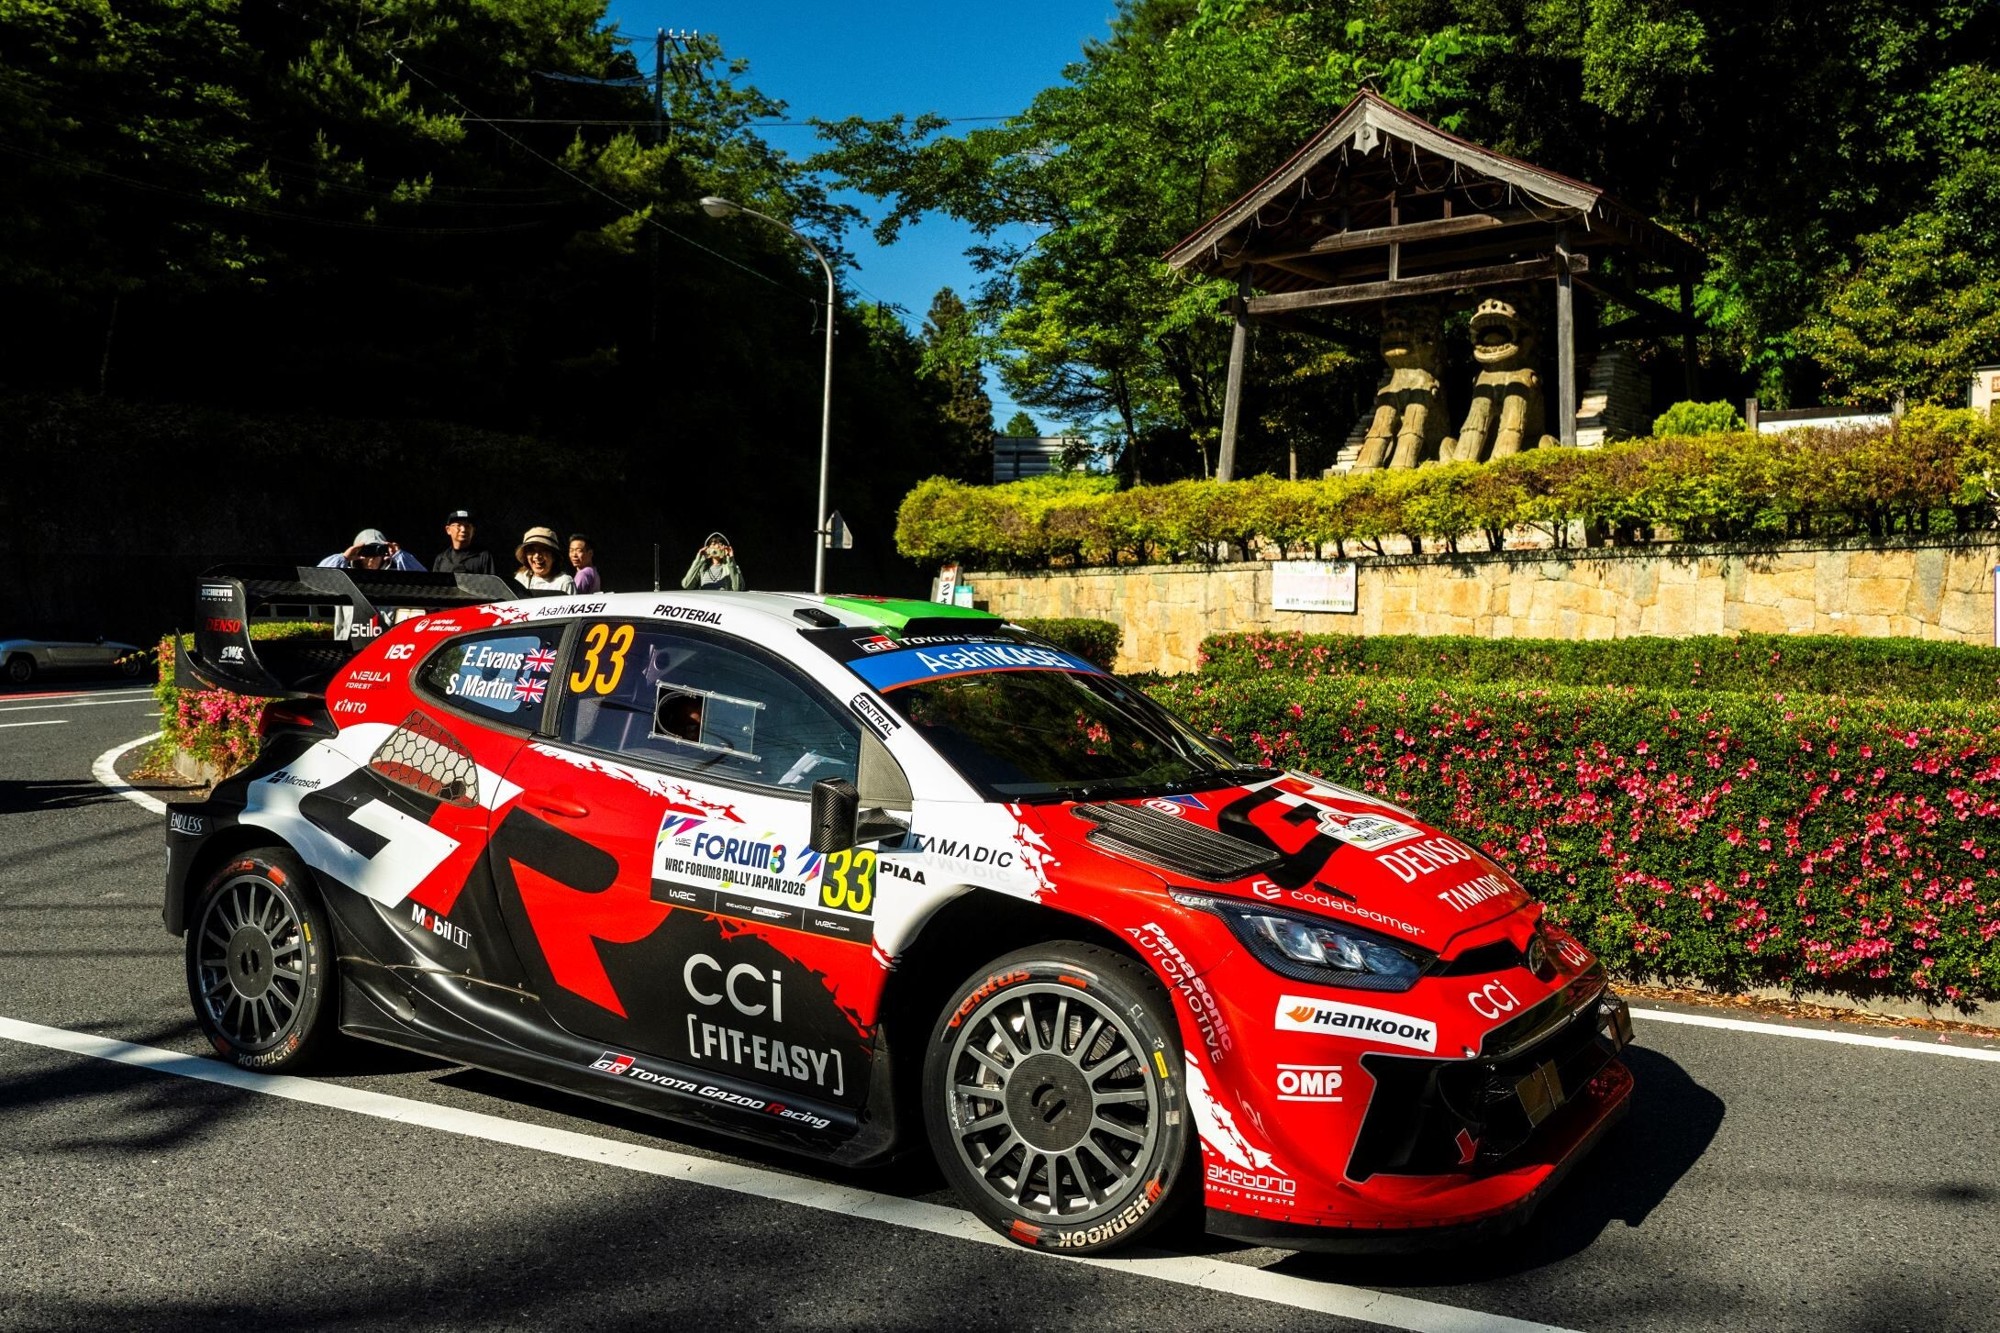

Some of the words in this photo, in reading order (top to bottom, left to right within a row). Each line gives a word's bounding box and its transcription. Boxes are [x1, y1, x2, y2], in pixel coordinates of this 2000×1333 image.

[535, 603, 607, 616] AsahiKASEI
[653, 604, 723, 626] PROTERIAL
[206, 617, 241, 633] DENSO
[351, 617, 382, 637] Stilo
[897, 634, 964, 647] TOYOTA
[462, 645, 525, 670] E.Evans
[569, 623, 635, 695] 33
[915, 646, 1076, 673] AsahiKASEI
[445, 674, 513, 700] S.Martin
[852, 692, 894, 737] CENTRAL
[281, 774, 321, 789] Microsoft
[170, 812, 202, 834] ENDLESS
[693, 832, 787, 874] FORUM8
[913, 833, 1013, 868] TAMADIC
[1375, 837, 1472, 884] DENSO
[664, 857, 684, 872] WRC
[684, 861, 722, 881] FORUM8
[721, 866, 751, 886] RALLY
[751, 873, 781, 892] JAPAN
[781, 880, 807, 897] 2026
[822, 849, 877, 913] 33
[879, 860, 926, 886] PIAA
[669, 888, 696, 902] WRC
[1436, 873, 1510, 913] TAMADIC
[411, 904, 452, 941] Mobil
[1290, 889, 1421, 936] codebeamer
[1124, 927, 1224, 1064] AUTOMOTIVE
[1141, 922, 1233, 1052] Panasonic
[1276, 1070, 1343, 1095] OMP
[629, 1067, 698, 1093] TOYOTA
[698, 1086, 766, 1109] GAZOO
[764, 1102, 831, 1130] Racing
[1205, 1184, 1239, 1196] BRAKE
[1245, 1193, 1295, 1207] EXPERTS
